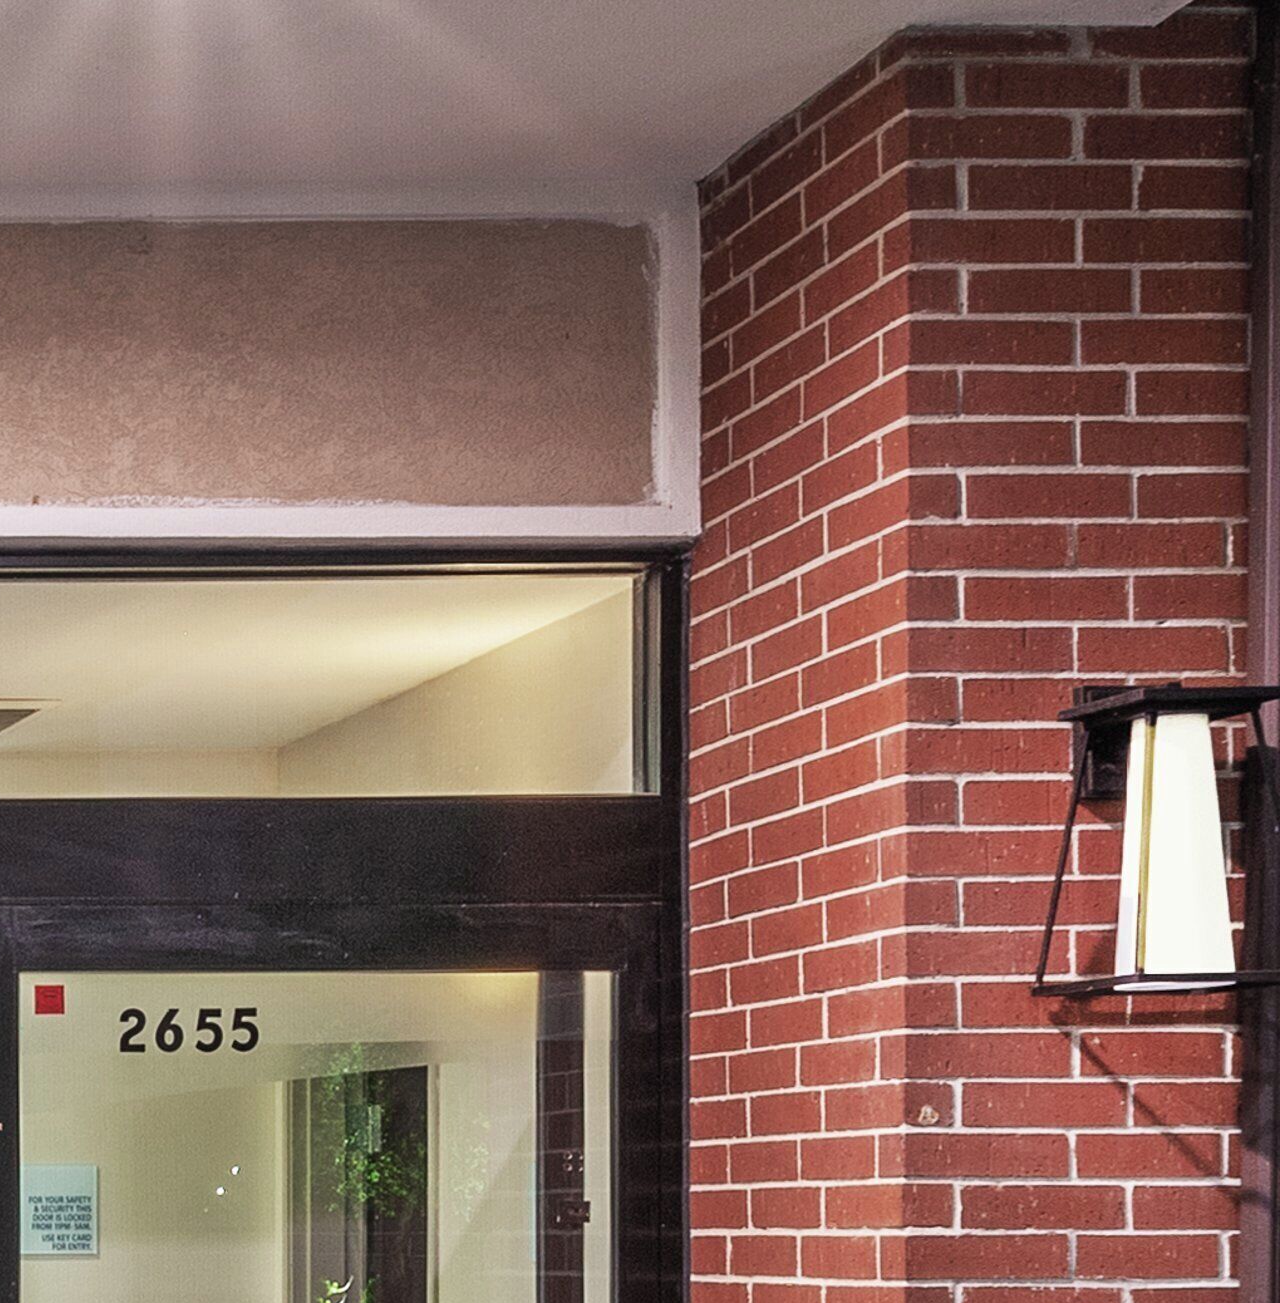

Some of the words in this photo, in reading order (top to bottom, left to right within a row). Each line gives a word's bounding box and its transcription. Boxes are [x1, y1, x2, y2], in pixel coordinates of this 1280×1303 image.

[119, 1007, 260, 1053] 2655
[28, 1196, 43, 1204] FOR
[45, 1196, 64, 1204] YOUR
[66, 1196, 92, 1204] SAFETY
[40, 1205, 74, 1213] SECURITY
[76, 1205, 92, 1213] THIS
[32, 1214, 54, 1222] DOOR
[55, 1214, 62, 1222] IS
[63, 1214, 93, 1222] LOCKED
[31, 1223, 53, 1231] FROM
[41, 1234, 55, 1242] USE
[56, 1234, 70, 1242] KEY
[71, 1234, 93, 1242] CARD
[52, 1242, 66, 1250] FOR
